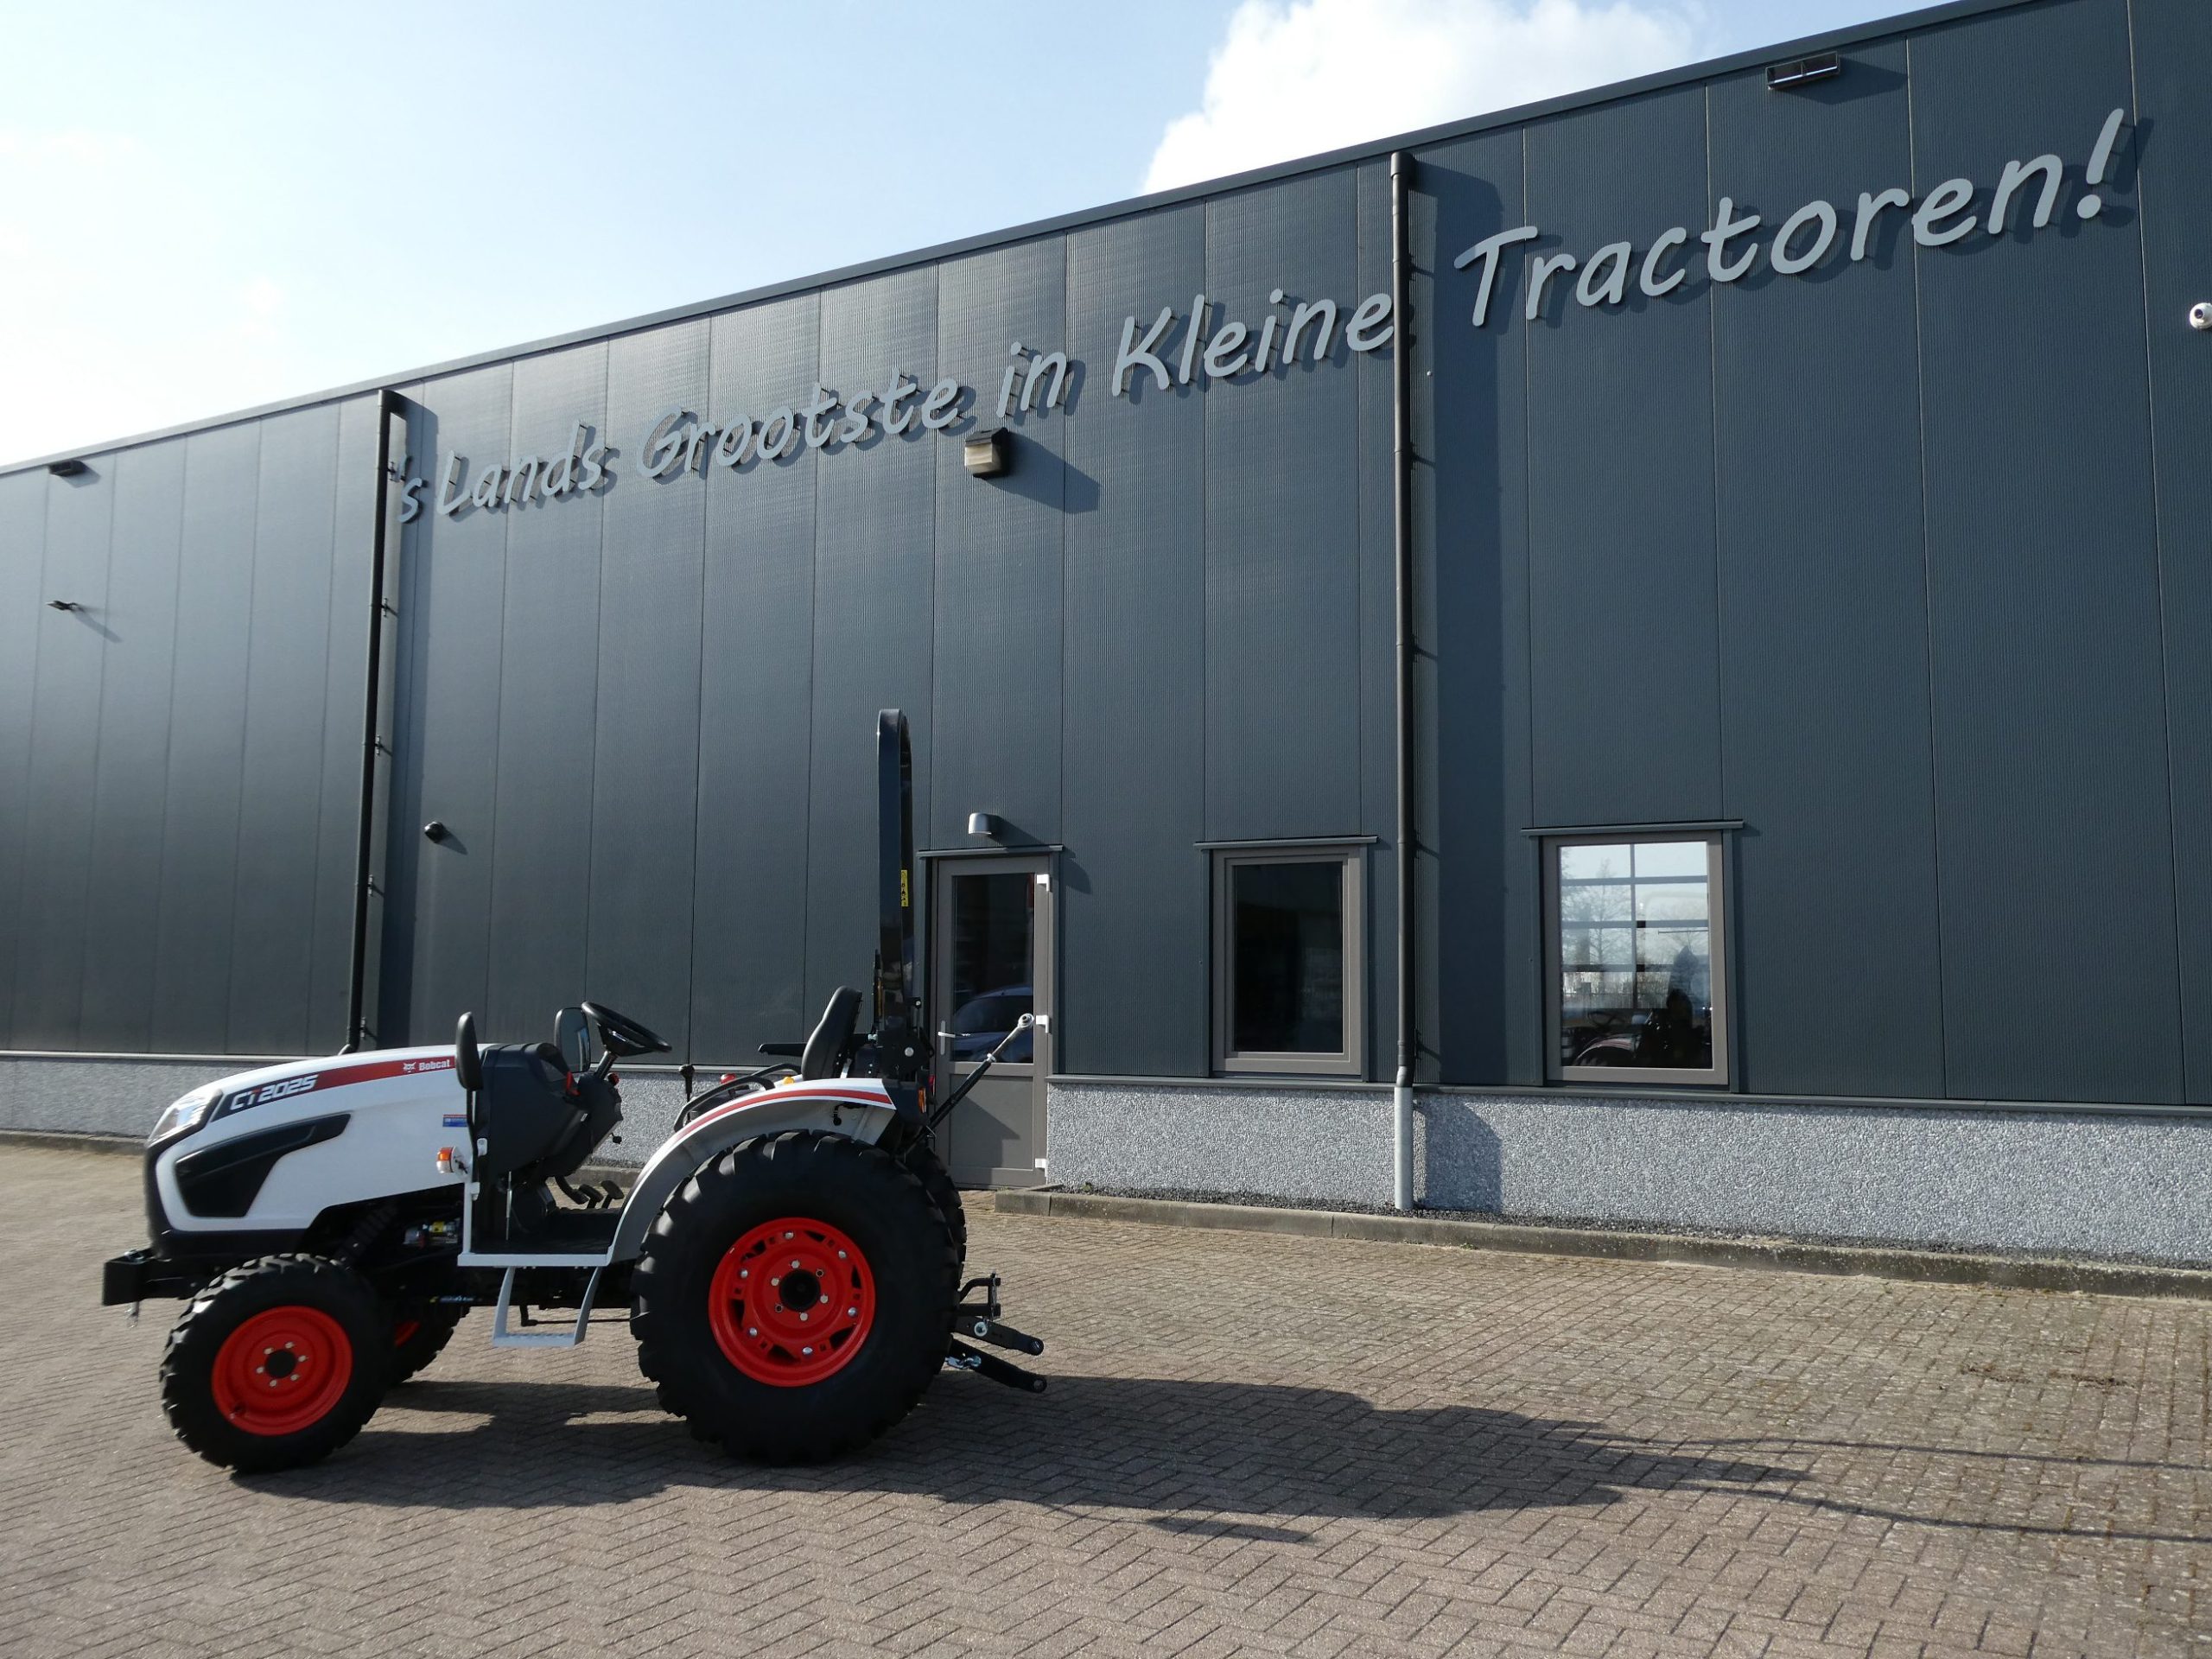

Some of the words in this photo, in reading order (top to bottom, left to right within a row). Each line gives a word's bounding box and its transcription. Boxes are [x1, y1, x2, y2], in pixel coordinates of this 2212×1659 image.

[435, 420, 608, 517] Lands
[636, 367, 959, 478] Grootste
[996, 342, 1067, 418] in
[1111, 288, 1395, 397] Kleine
[1453, 108, 2125, 327] Tractoren!
[418, 1059, 451, 1071] Bobcat
[230, 1074, 319, 1111] CT2025
